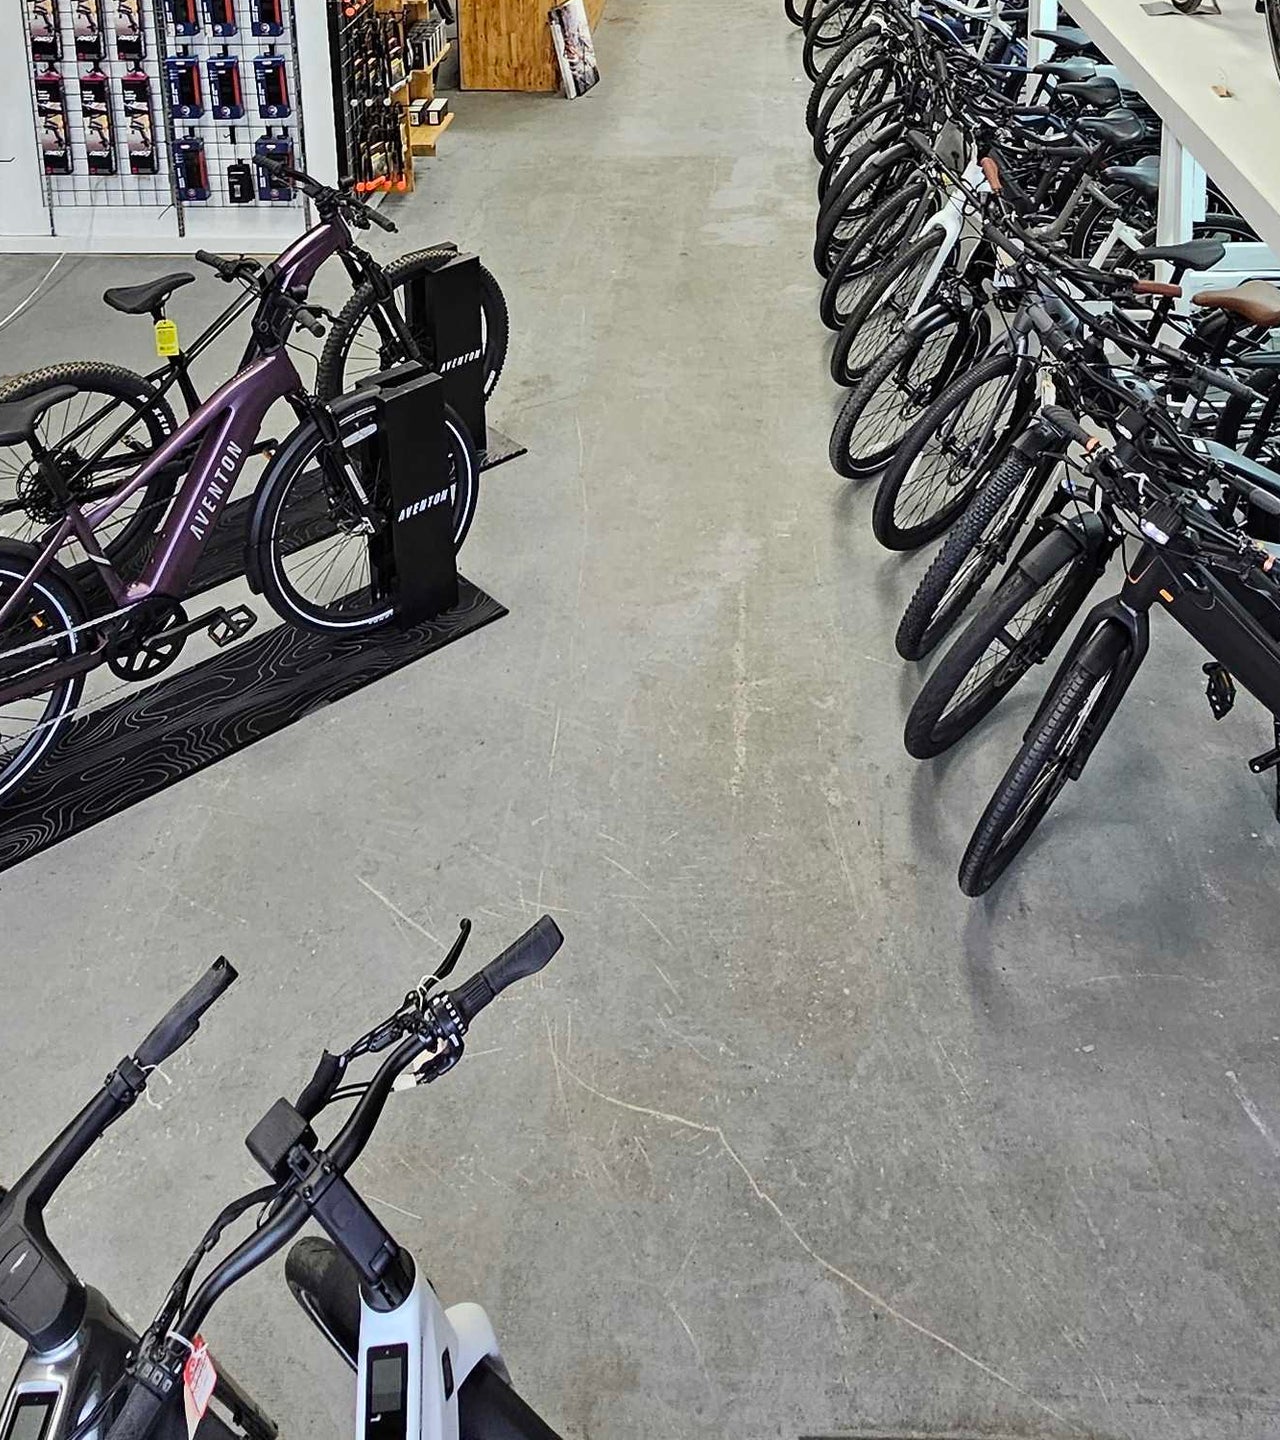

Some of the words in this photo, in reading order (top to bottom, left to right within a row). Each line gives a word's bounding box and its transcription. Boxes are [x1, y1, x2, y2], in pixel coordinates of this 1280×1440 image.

[440, 349, 481, 373] AVENTON
[189, 440, 242, 540] AVENTON
[398, 488, 449, 523] AVENTON
